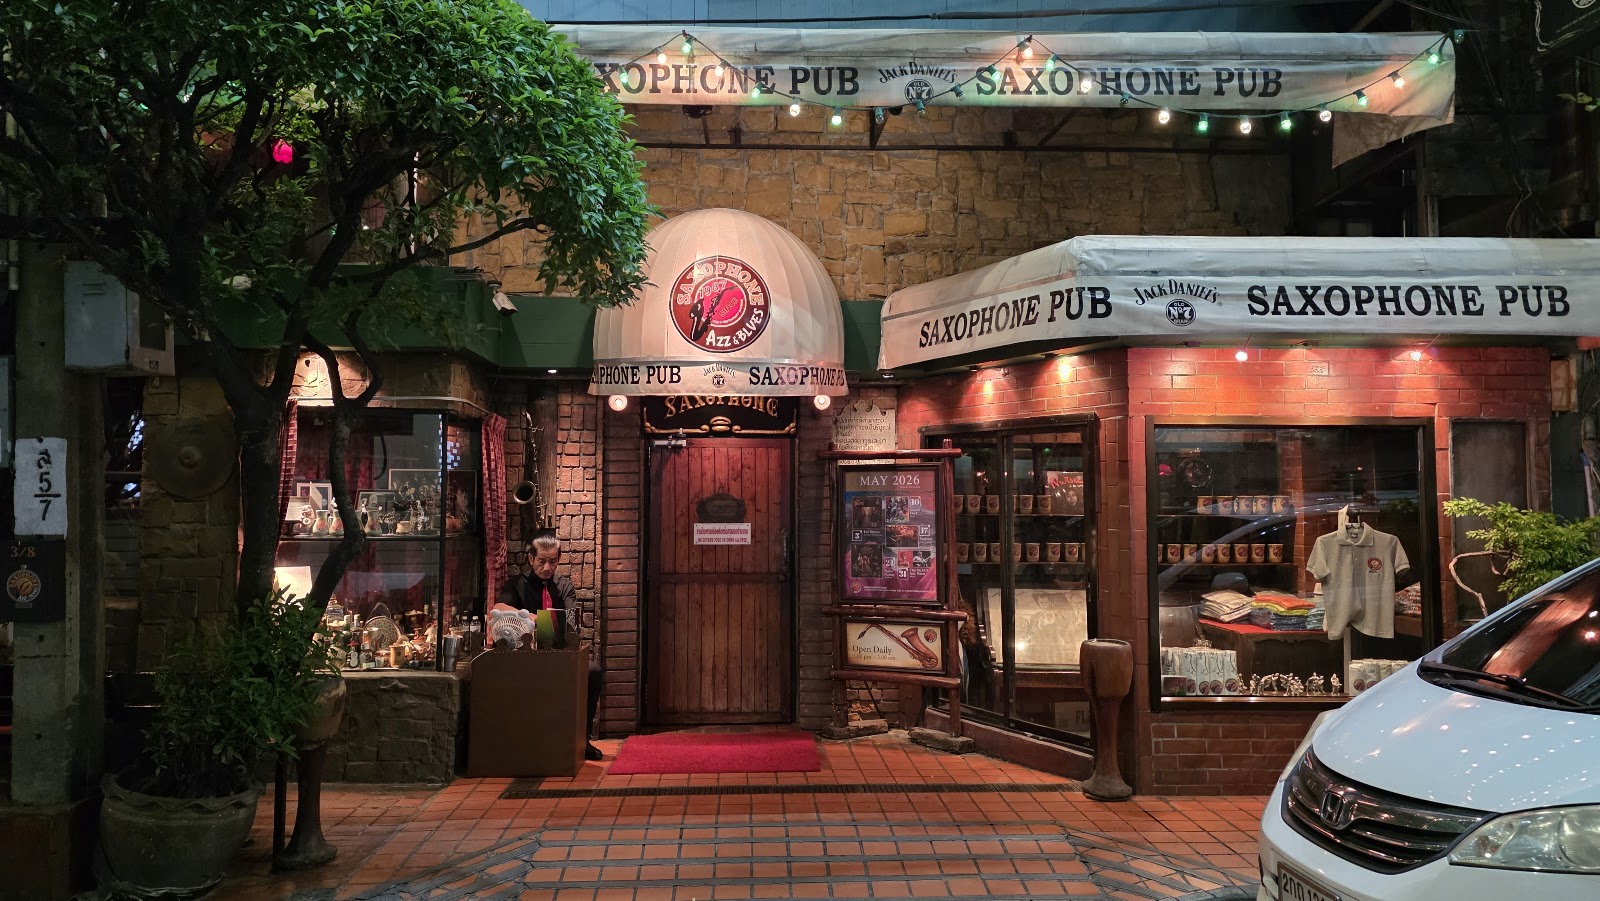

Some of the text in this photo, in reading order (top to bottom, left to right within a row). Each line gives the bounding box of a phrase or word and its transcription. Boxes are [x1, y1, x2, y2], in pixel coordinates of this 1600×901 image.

[789, 66, 859, 95] PUB
[878, 65, 908, 83] JACK
[976, 66, 1282, 98] SAXOPHONE PUB
[677, 261, 765, 305] SAXOPHONE
[699, 280, 727, 298] 1987
[1133, 283, 1168, 305] JACK
[1247, 285, 1570, 317] SAXOPHONE PUB
[919, 286, 1113, 348] SAXOPHONE PUB
[646, 365, 681, 385] PUB
[749, 366, 836, 386] SAXOPHONE
[860, 474, 920, 486] MAY 2026
[910, 498, 920, 506] 10
[11, 546, 35, 557] 3/8
[852, 645, 892, 656] Open Daily
